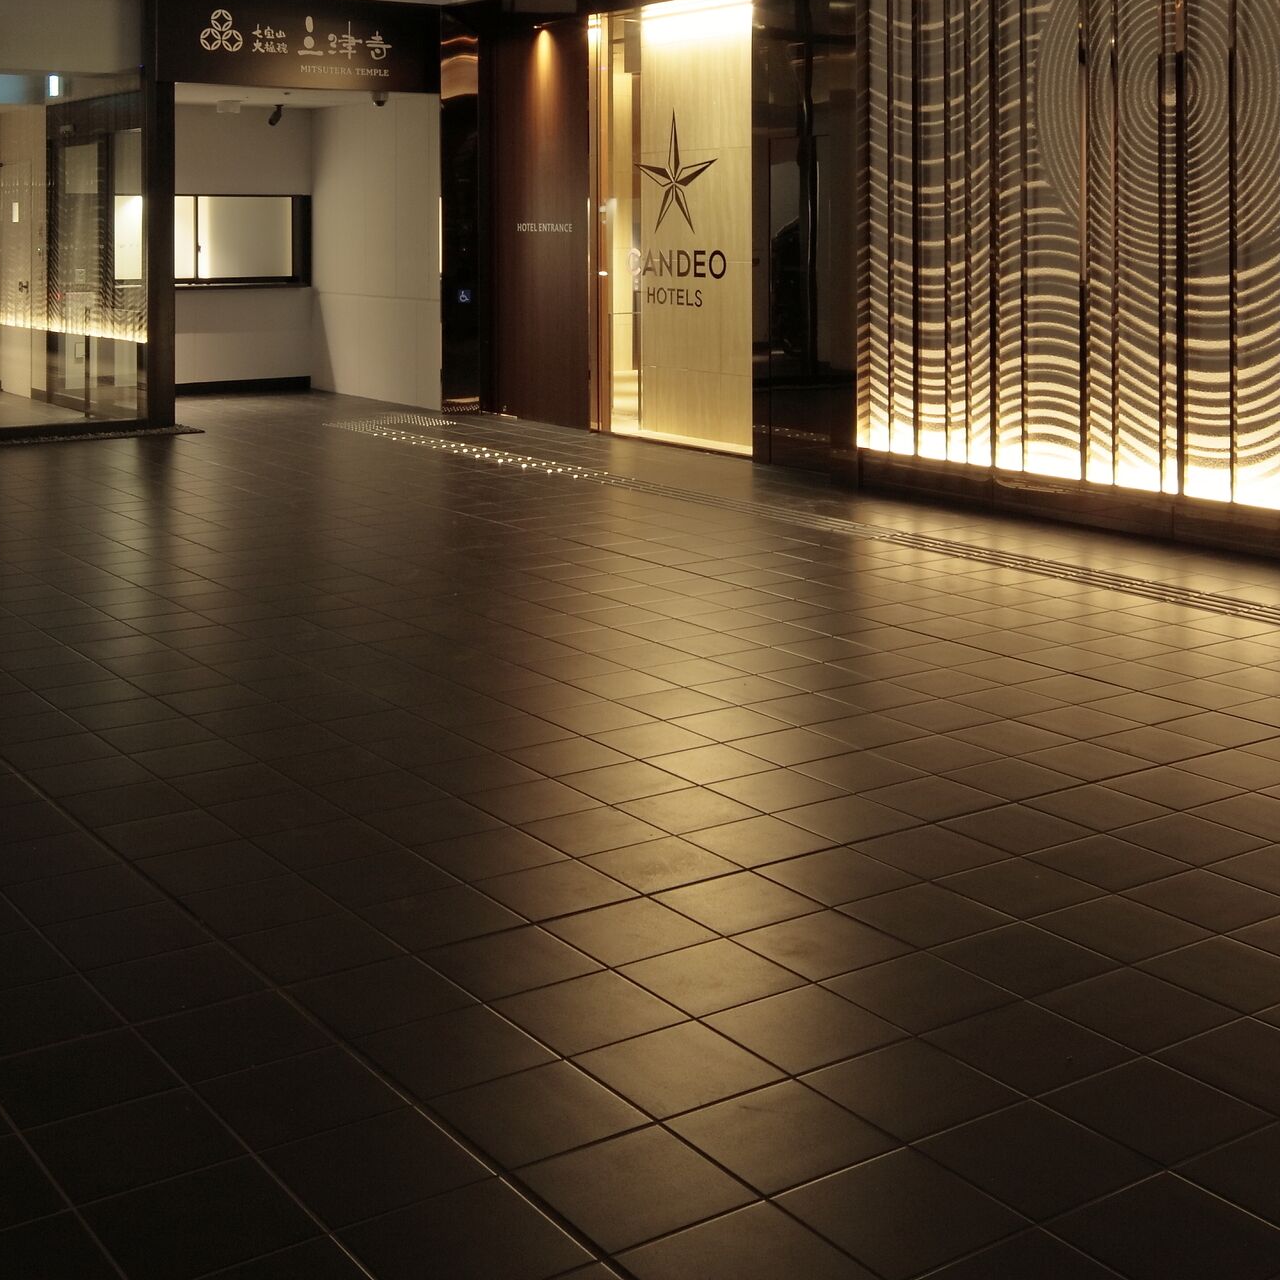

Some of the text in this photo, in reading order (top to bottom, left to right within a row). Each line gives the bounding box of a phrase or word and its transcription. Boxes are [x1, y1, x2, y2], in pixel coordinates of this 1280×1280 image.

[300, 65, 390, 77] MITSUTERA TEMPLE
[517, 223, 573, 233] HOTEL ENTRANCE
[627, 248, 727, 280] CANDEO
[647, 287, 703, 308] HOTELS
